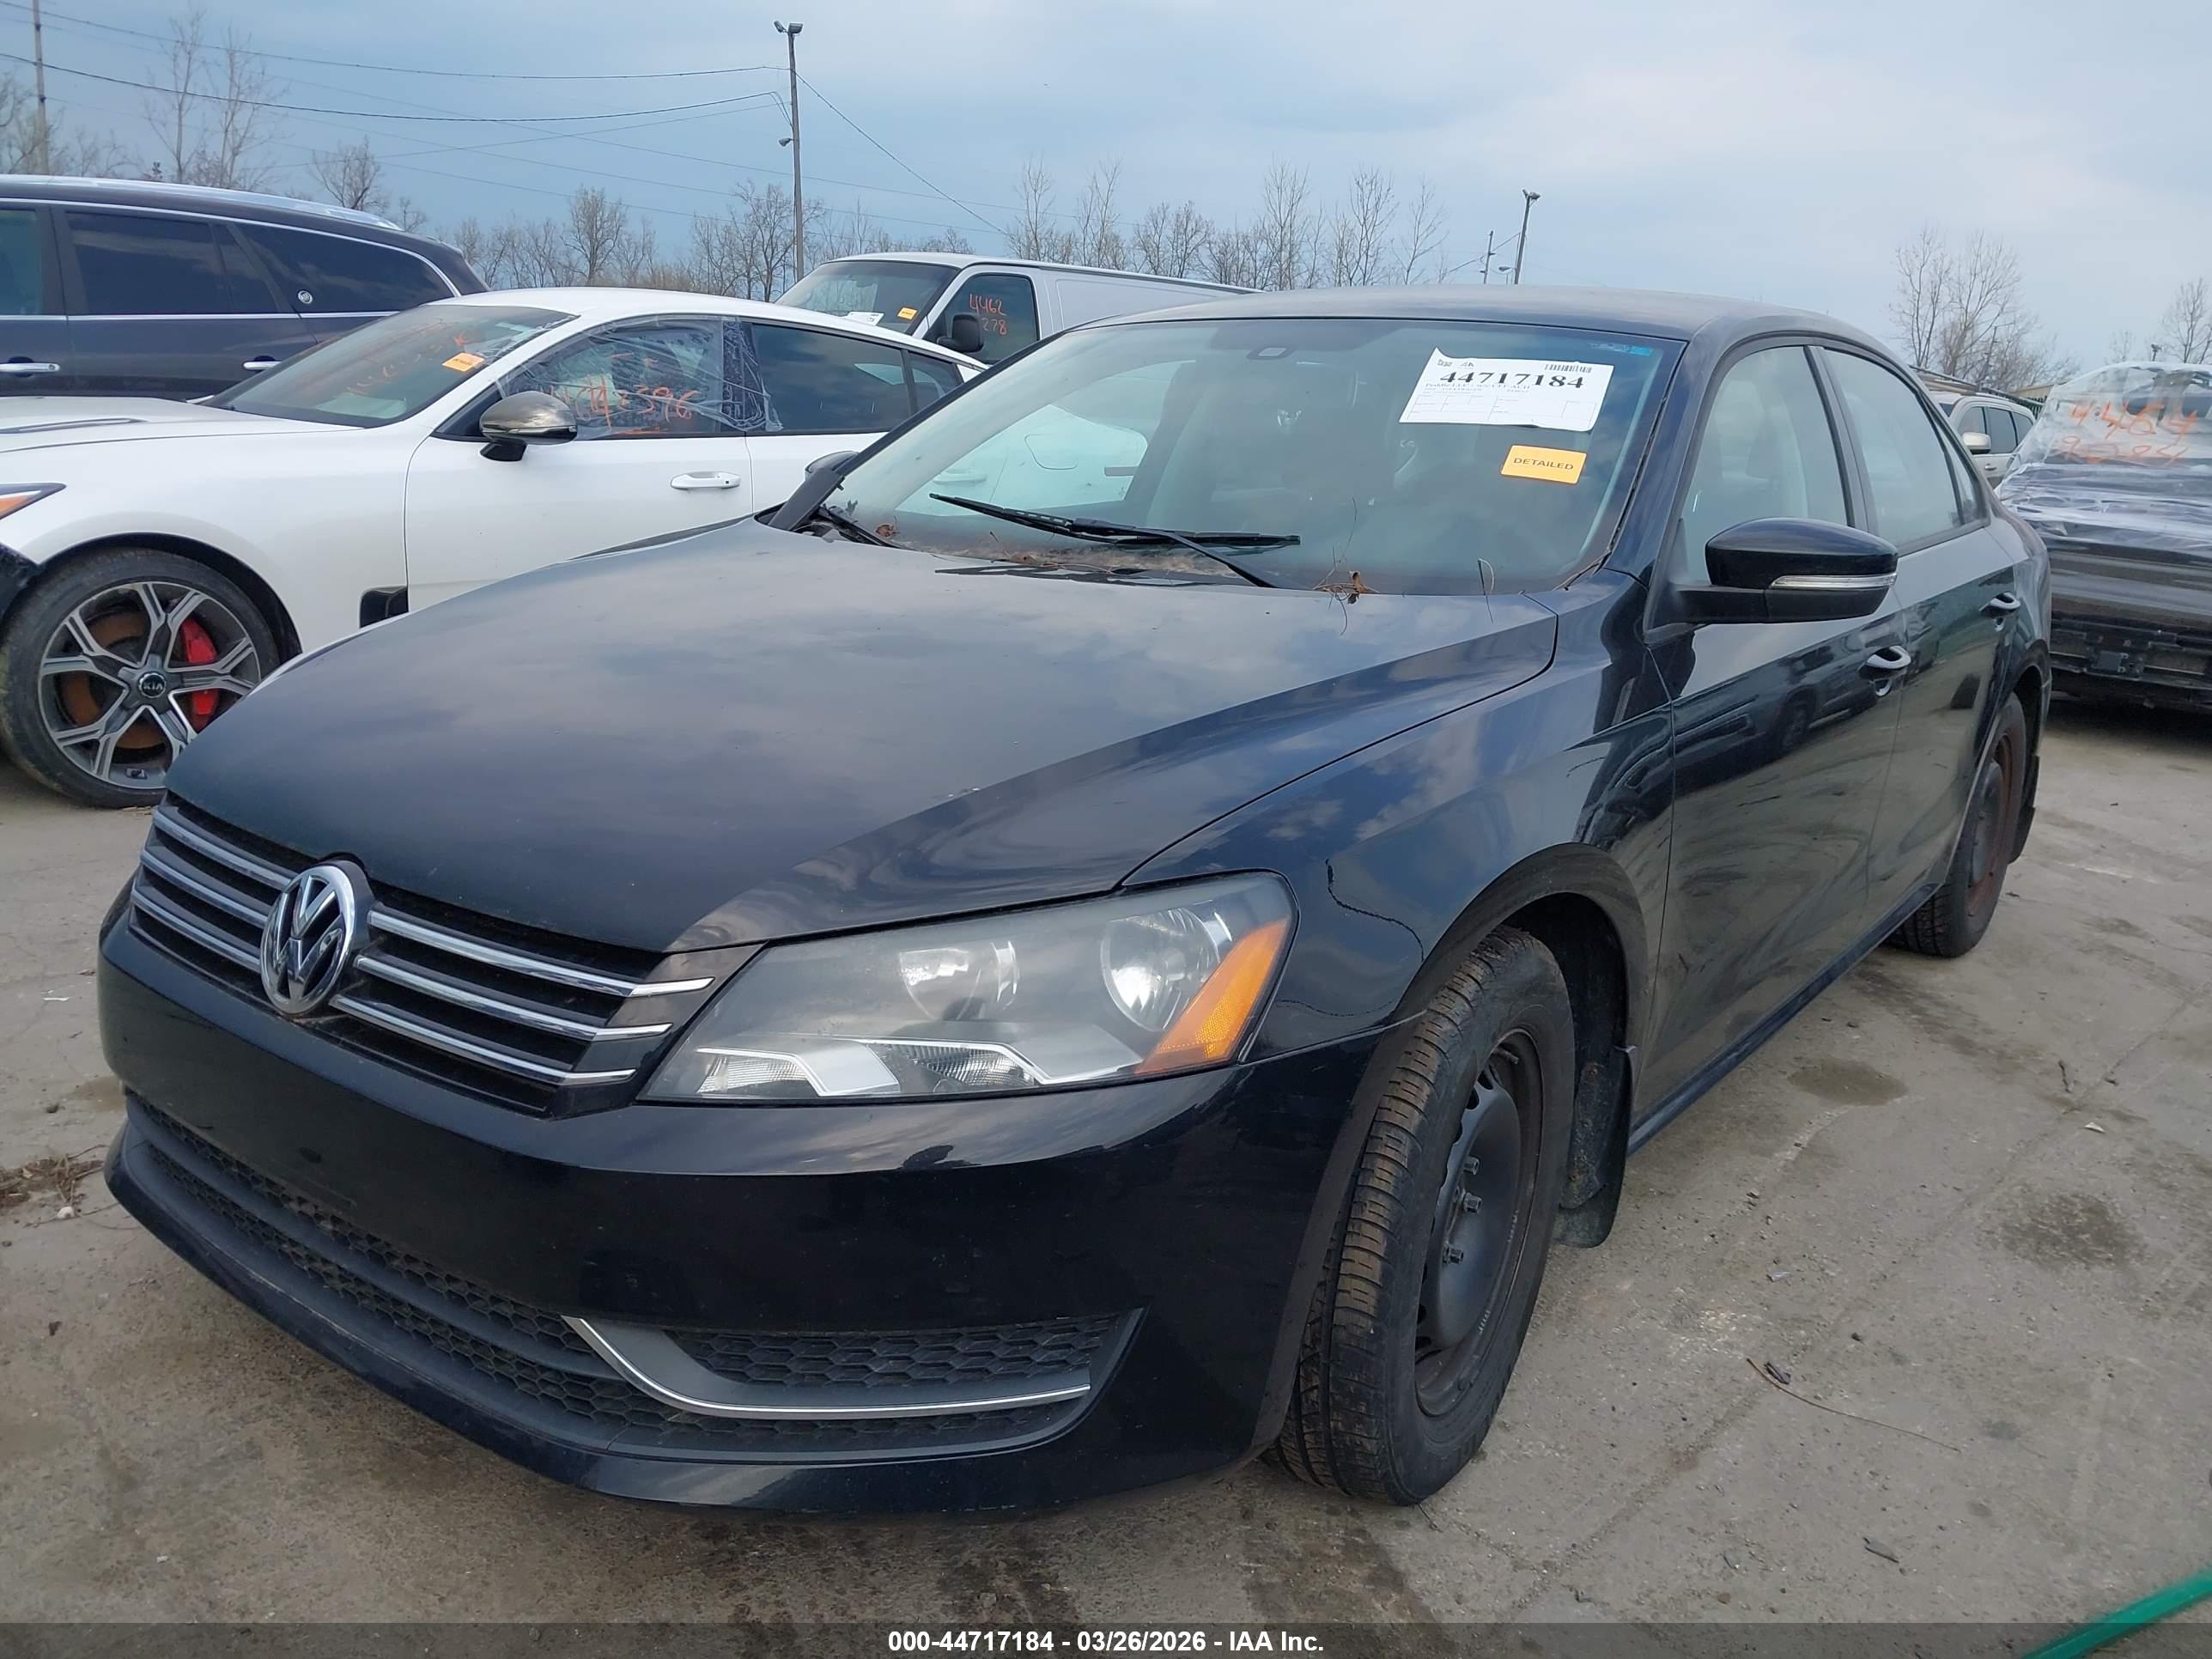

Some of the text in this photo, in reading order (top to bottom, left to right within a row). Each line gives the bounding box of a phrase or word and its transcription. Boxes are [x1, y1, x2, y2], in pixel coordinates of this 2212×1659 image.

[969, 292, 1007, 316] 4462
[1440, 371, 1583, 388] 44717184
[1513, 457, 1574, 471] DETAILED
[143, 681, 163, 690] KIA
